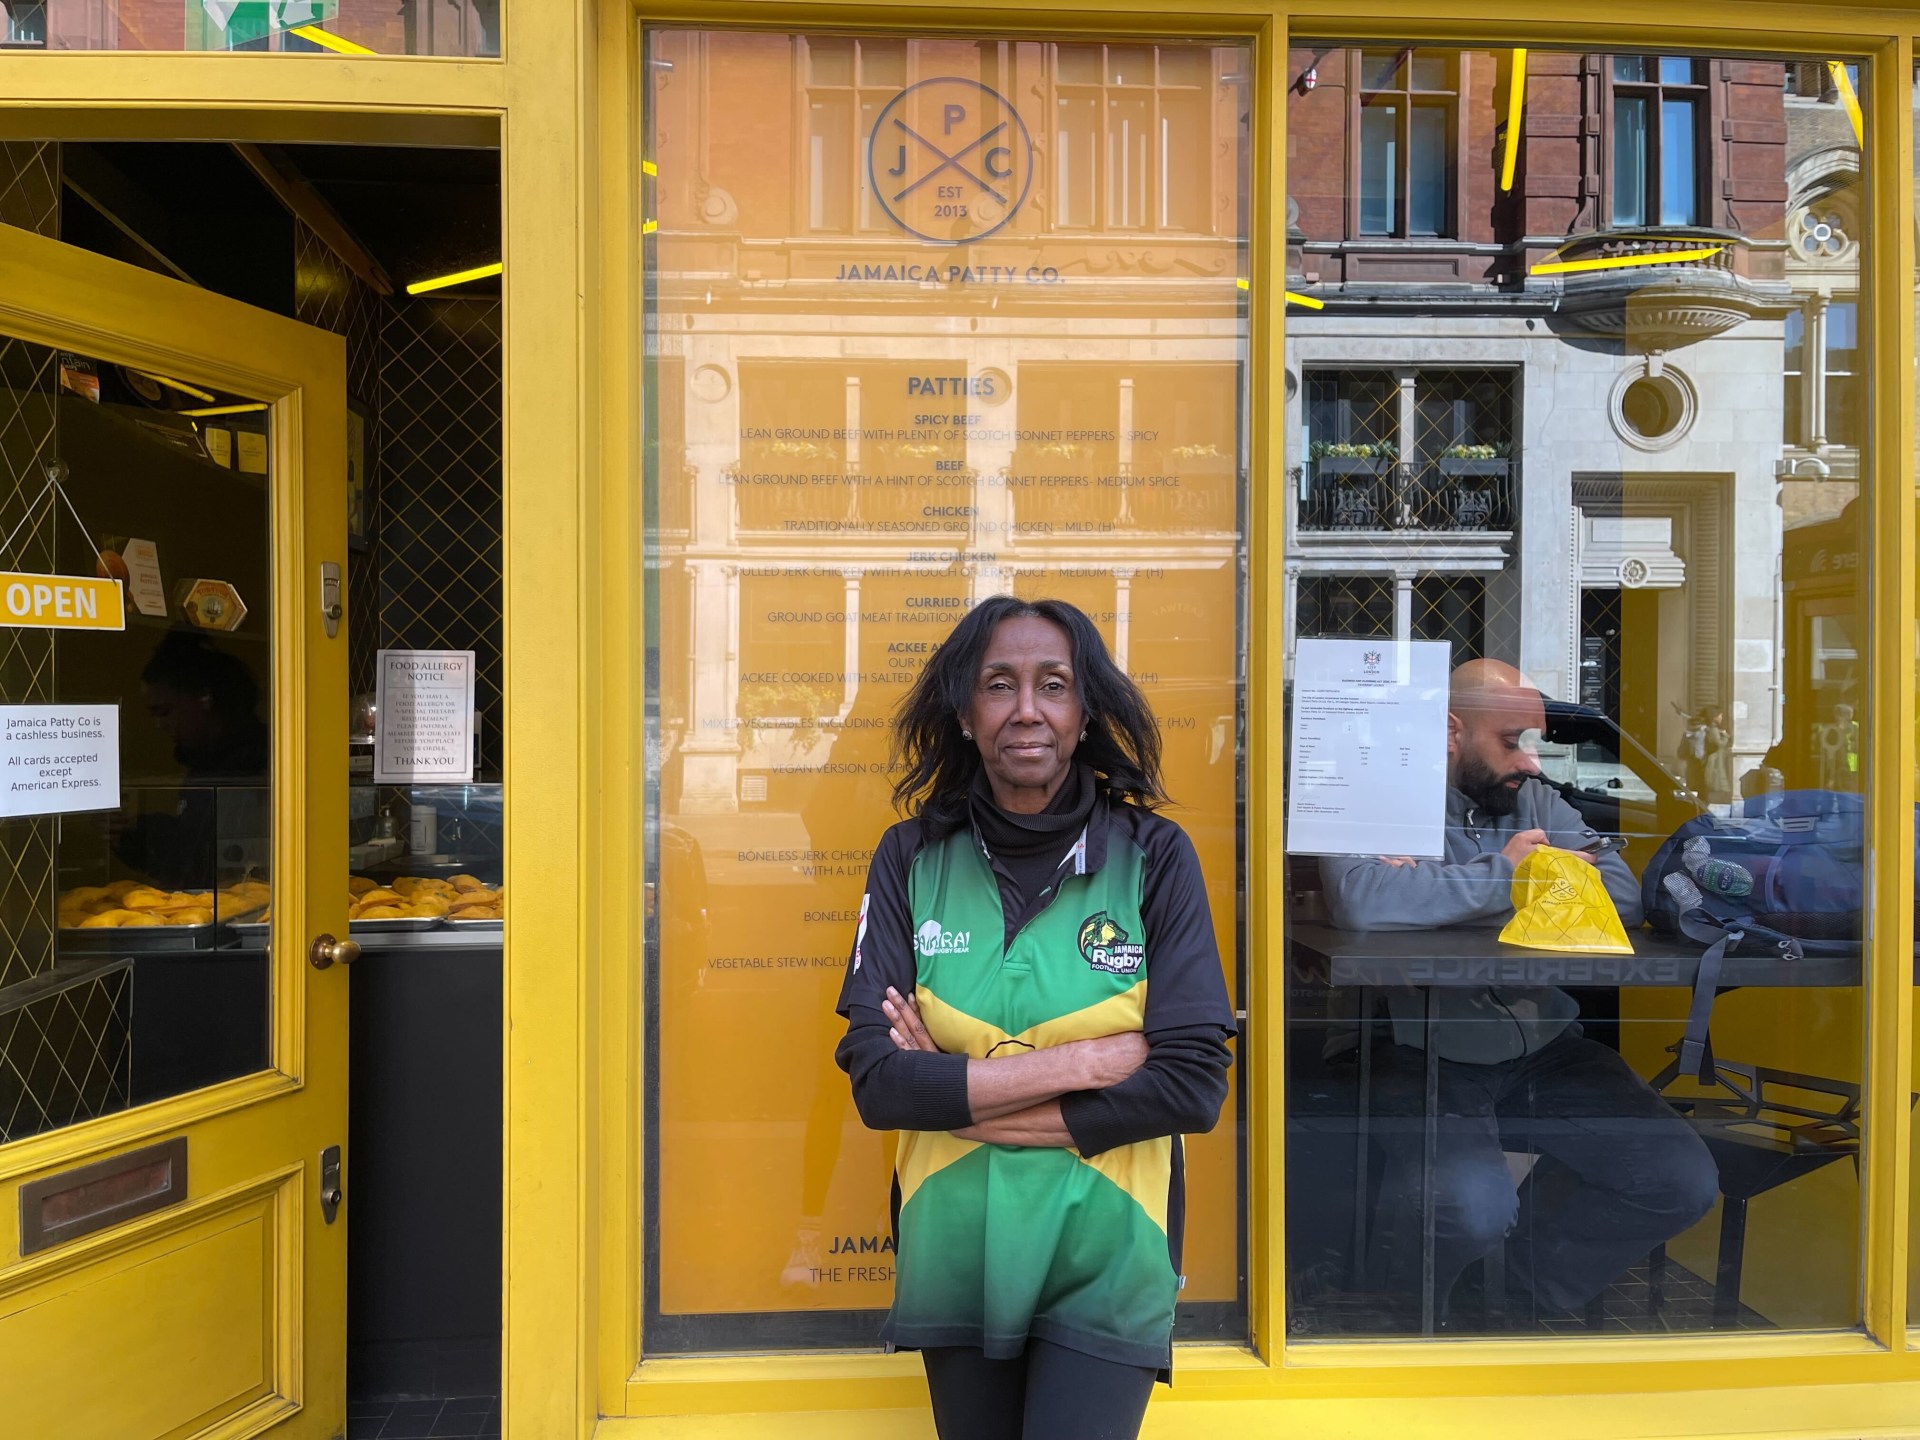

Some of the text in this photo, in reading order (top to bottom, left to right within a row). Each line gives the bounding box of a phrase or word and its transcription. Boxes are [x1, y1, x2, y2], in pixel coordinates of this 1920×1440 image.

[944, 104, 966, 135] P
[888, 145, 1013, 178] J C
[938, 186, 963, 199] EST
[934, 205, 968, 218] 2013
[836, 264, 1066, 284] JAMAICA PATTY CO.
[908, 377, 995, 396] PATTIES
[914, 414, 981, 425] SPICY BEEF
[740, 428, 771, 439] LEAN
[775, 428, 830, 440] GROUND
[833, 429, 861, 440] BEEF
[863, 429, 893, 440] WITH
[897, 430, 942, 440] PLENTY
[943, 429, 959, 441] OF
[962, 430, 1011, 441] SCOTCH
[1014, 430, 1063, 441] BONNET
[1066, 430, 1115, 441] PEPPERS
[1127, 430, 1159, 441] SPICY
[936, 460, 964, 471] BEEF
[718, 473, 749, 485] LEAN
[752, 474, 808, 485] GROUND
[811, 474, 838, 485] BEEF
[841, 475, 872, 486] WITH
[875, 475, 887, 486] A
[887, 475, 914, 486] HINT
[917, 475, 932, 486] OF
[936, 475, 984, 487] SCOTCH
[988, 475, 1036, 487] BONNET
[1097, 476, 1145, 487] MEDIUM
[1148, 476, 1180, 487] SPICE
[923, 506, 979, 517] CHICKEN
[784, 521, 874, 531] TRADITIONALLY
[877, 521, 940, 532] SEASONED
[943, 521, 997, 532] GROUND
[1000, 522, 1053, 532] CHICKEN
[1065, 522, 1094, 532] MILD
[1098, 521, 1116, 533] (H)
[906, 552, 996, 562] JERK CHICKEN
[735, 566, 779, 577] PULLED
[782, 567, 810, 577] JERK
[813, 567, 867, 577] CHICKEN
[868, 567, 901, 577] WITH
[904, 567, 914, 577] A
[915, 567, 957, 578] TOUCH
[960, 567, 976, 578] OF
[1059, 568, 1107, 578] MEDIUM
[1110, 568, 1142, 578] SPICE
[1146, 567, 1164, 579] (H)
[6, 582, 97, 619] OPEN
[905, 597, 960, 608] CURRIED
[767, 612, 823, 623] GROUND
[825, 612, 858, 623] GOAT
[861, 612, 892, 623] MEAT
[896, 612, 965, 623] TRADITIONA
[1101, 612, 1133, 623] SPICE
[887, 642, 928, 653] ACKEE
[390, 661, 463, 671] FOOD ALLERGY
[888, 657, 915, 668] OUR
[407, 672, 445, 681] NOTICE
[740, 672, 778, 683] ACKEE
[782, 672, 834, 684] COOKED
[836, 672, 867, 683] WITH
[870, 672, 913, 683] SALTED
[1141, 672, 1159, 684] (H)
[6, 716, 101, 730] Jamaica Patty Co is
[702, 718, 739, 729] MIXED
[741, 718, 814, 729] VEGETABLES
[817, 717, 884, 728] INCLUDING
[1167, 717, 1196, 728] (H,V)
[5, 729, 105, 741] a cashless business.
[8, 753, 98, 766] All cards accepted
[394, 756, 455, 765] THANK YOU
[39, 767, 72, 779] except
[771, 763, 812, 774] VEGAN
[816, 763, 867, 774] VERSION
[869, 763, 886, 774] OF
[11, 778, 101, 791] American Express.
[738, 850, 798, 862] BONELESS
[800, 850, 829, 861] JERK
[802, 865, 833, 876] WITH
[836, 865, 845, 876] A
[1114, 945, 1143, 954] JAMAICA
[708, 957, 851, 969] VEGETABLE STEW INCLU
[1092, 949, 1143, 969] Rugby
[1091, 963, 1120, 974] FOOTBALL
[828, 1235, 896, 1254] JAMA
[809, 1267, 842, 1282] THE
